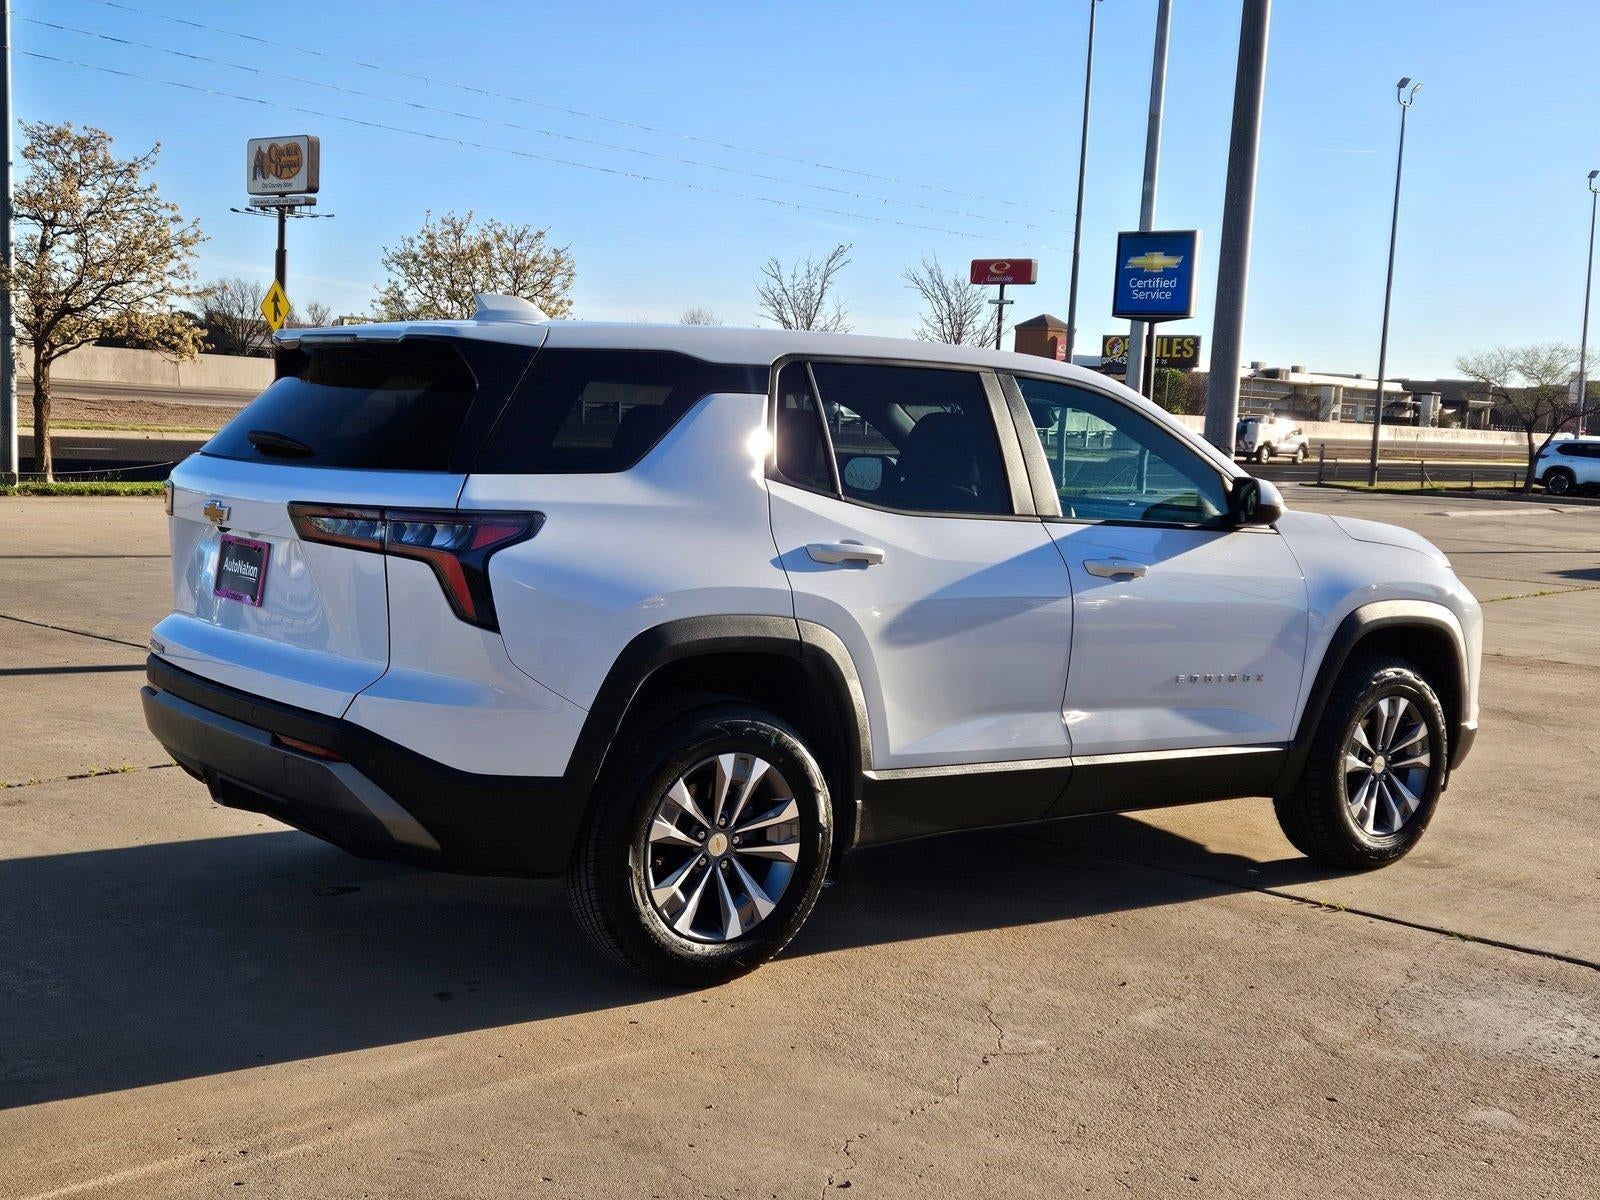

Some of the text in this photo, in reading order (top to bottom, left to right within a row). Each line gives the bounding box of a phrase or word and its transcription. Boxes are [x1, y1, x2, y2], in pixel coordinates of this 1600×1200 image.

[1129, 277, 1177, 288] Certified
[1131, 289, 1172, 299] Service
[1146, 337, 1195, 358] ILES
[223, 557, 258, 578] AutoNation
[1176, 674, 1264, 684] EQUINOX
